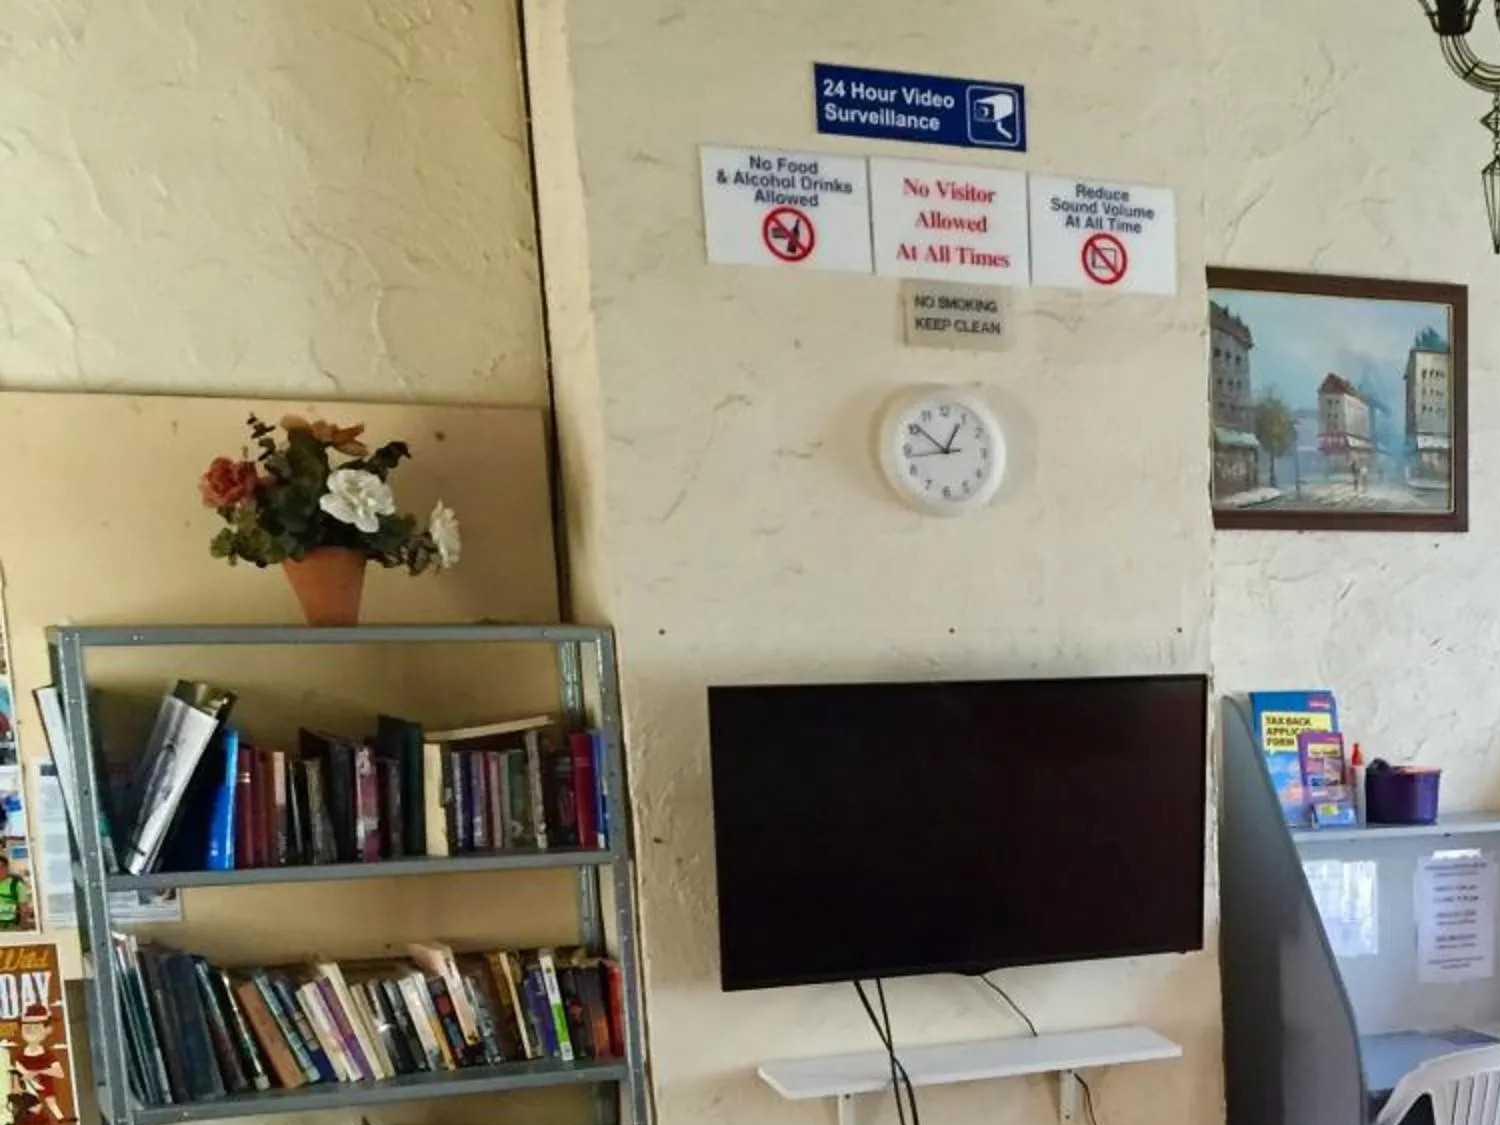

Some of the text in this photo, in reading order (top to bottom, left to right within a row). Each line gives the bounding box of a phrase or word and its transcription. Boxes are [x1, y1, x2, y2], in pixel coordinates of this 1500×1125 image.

[823, 79, 955, 109] 24 Hour Video
[824, 103, 941, 131] Surveillance
[750, 155, 818, 175] No Food
[716, 169, 853, 194] & Alcohol Drinks
[903, 177, 996, 204] No Visitor
[754, 189, 819, 207] Allowed
[1075, 183, 1130, 202] Reduce
[1049, 197, 1155, 220] Sound Volume
[915, 211, 988, 233] Allowed
[1065, 214, 1142, 234] At All Time
[896, 242, 1011, 269] At All Times
[914, 295, 998, 314] NO SMOKING
[914, 317, 1001, 335] KEEP CLEAN
[1286, 716, 1311, 726] BACK
[1266, 738, 1295, 747] FORM
